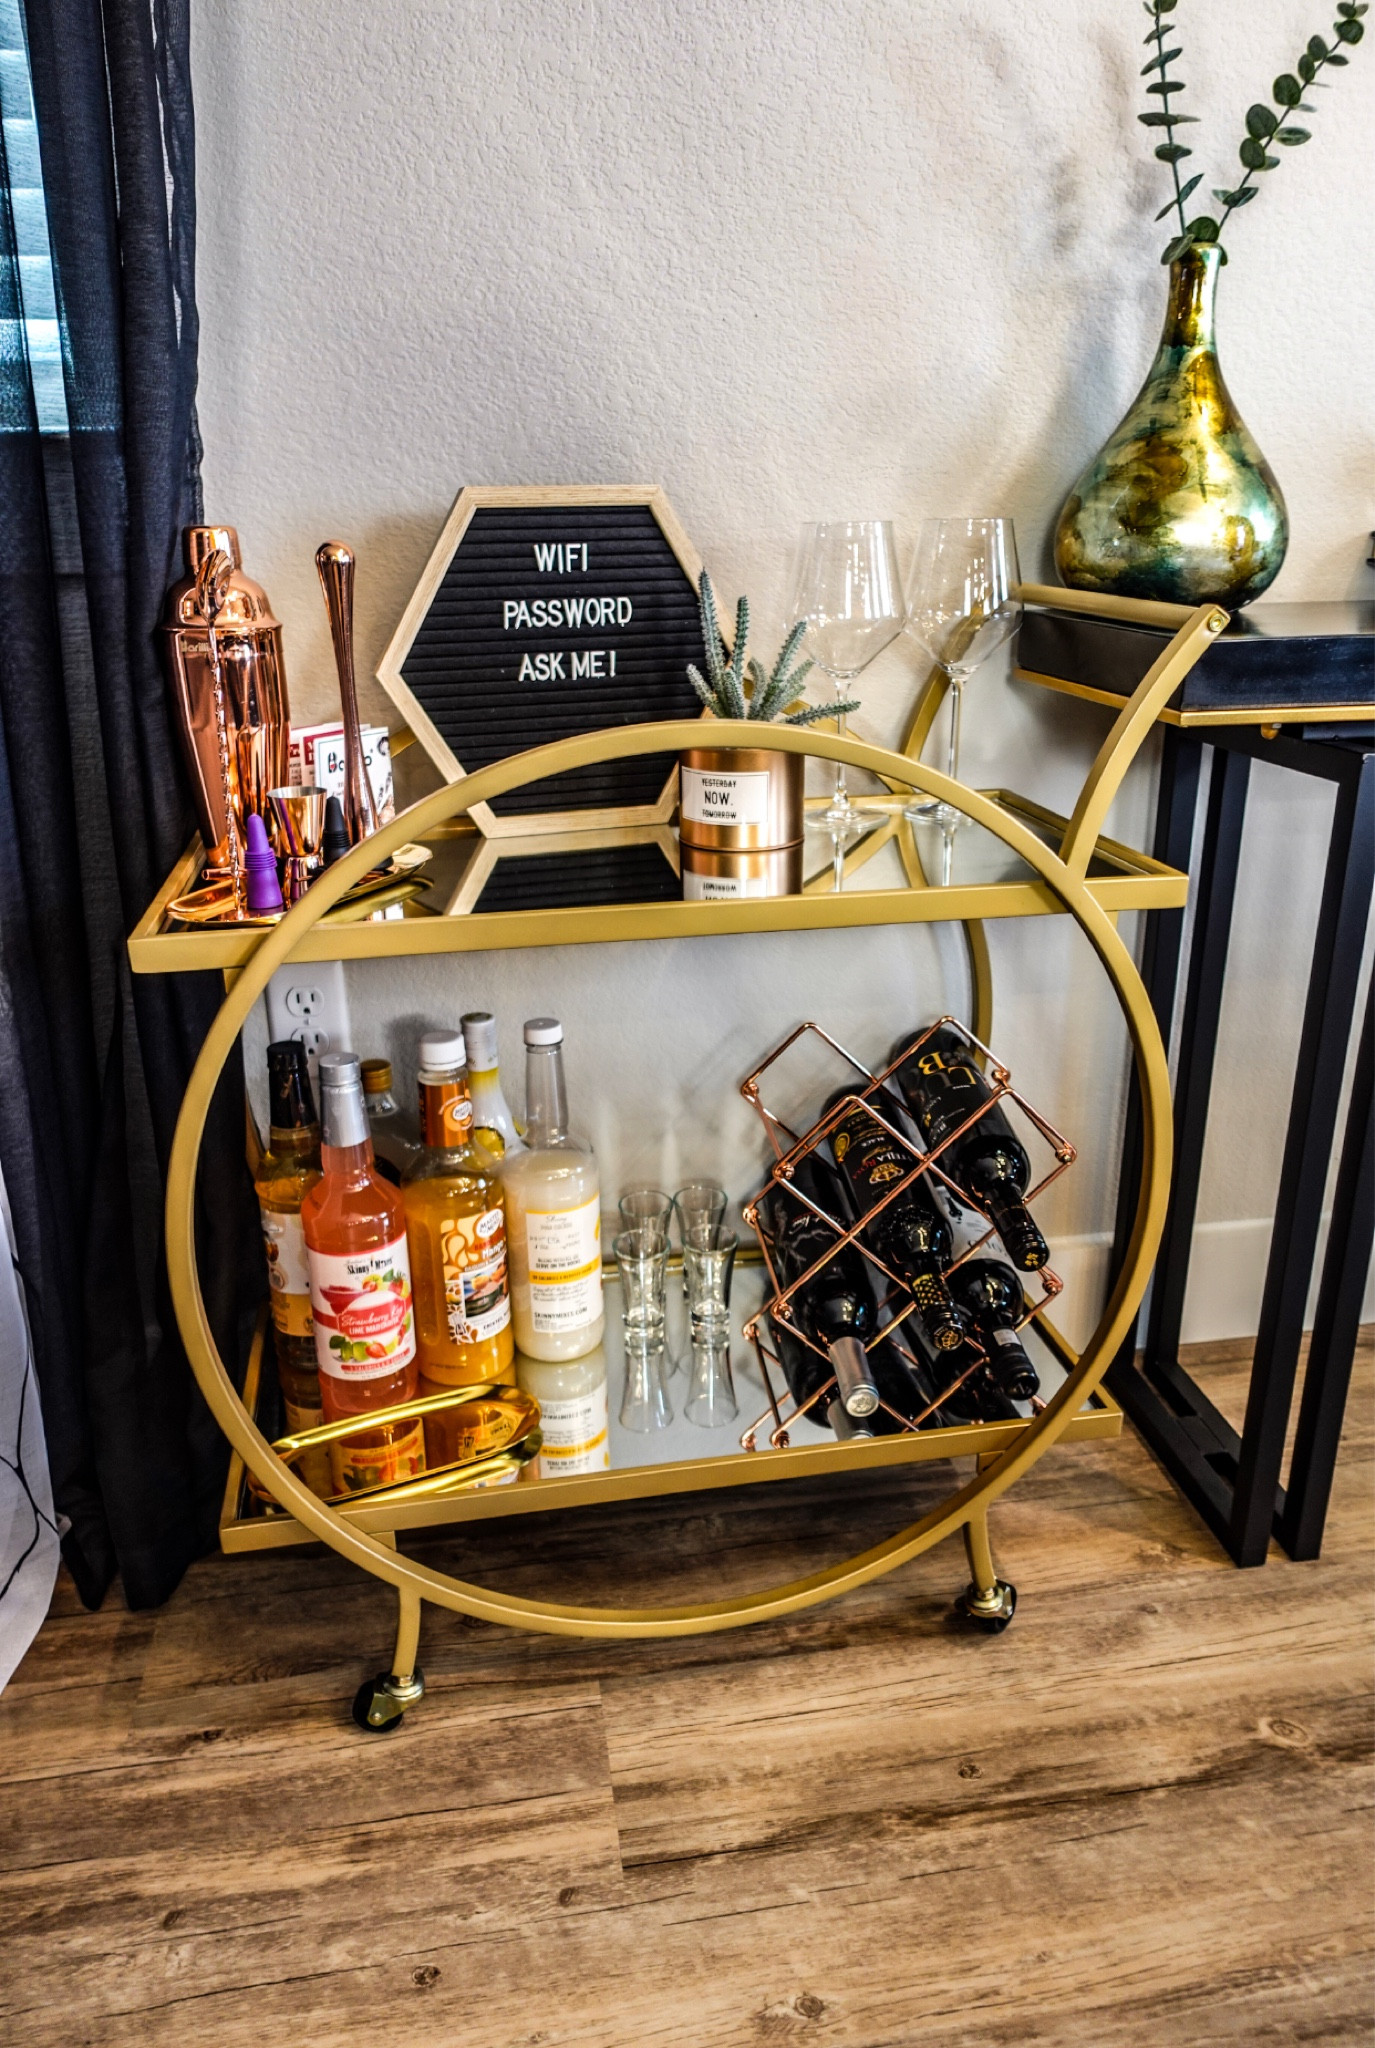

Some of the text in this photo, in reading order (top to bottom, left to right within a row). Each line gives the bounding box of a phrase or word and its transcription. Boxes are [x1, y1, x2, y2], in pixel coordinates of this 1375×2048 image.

[534, 543, 588, 574] WIFI
[504, 597, 633, 630] PASSWORD
[518, 650, 617, 682] ASK ME!
[701, 778, 736, 788] YESTERDAY
[702, 809, 737, 820] TOMORROW
